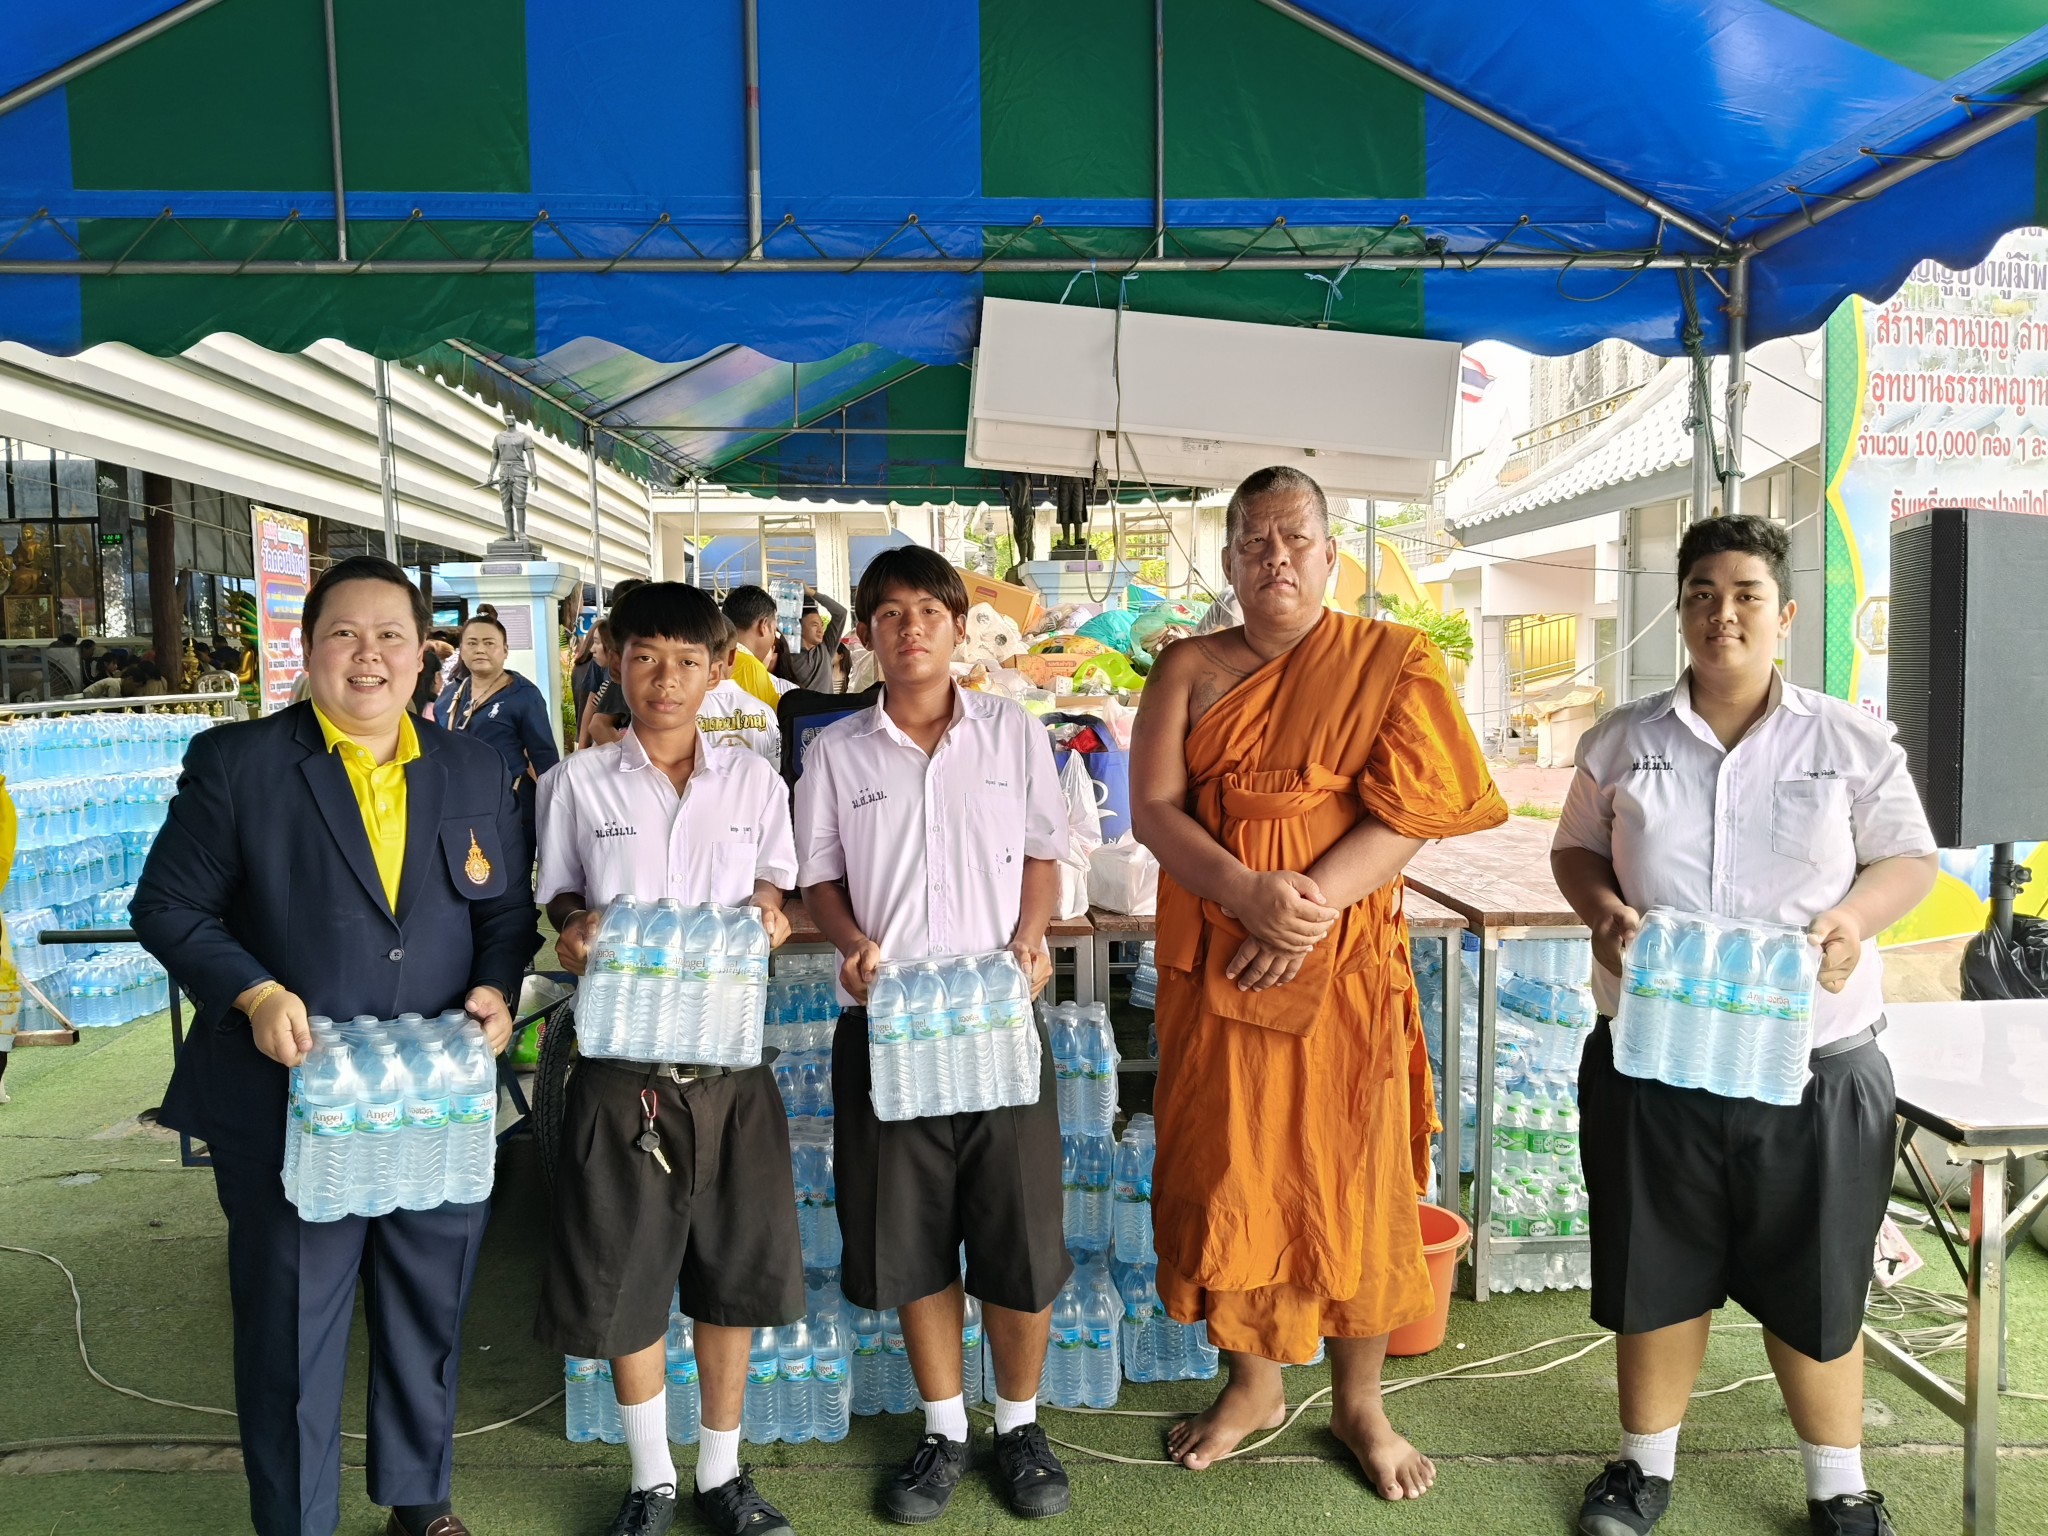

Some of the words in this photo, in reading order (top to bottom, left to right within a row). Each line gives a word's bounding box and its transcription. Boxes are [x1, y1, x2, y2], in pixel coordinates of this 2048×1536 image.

[1876, 301, 1924, 345] สร้าง
[1935, 316, 2009, 362] ลานบุญ
[1857, 424, 1908, 456] จำนวน
[1915, 430, 1976, 462] 10,000
[312, 1109, 343, 1125] Angel
[366, 1106, 396, 1122] Angel
[783, 1363, 804, 1374] Angel
